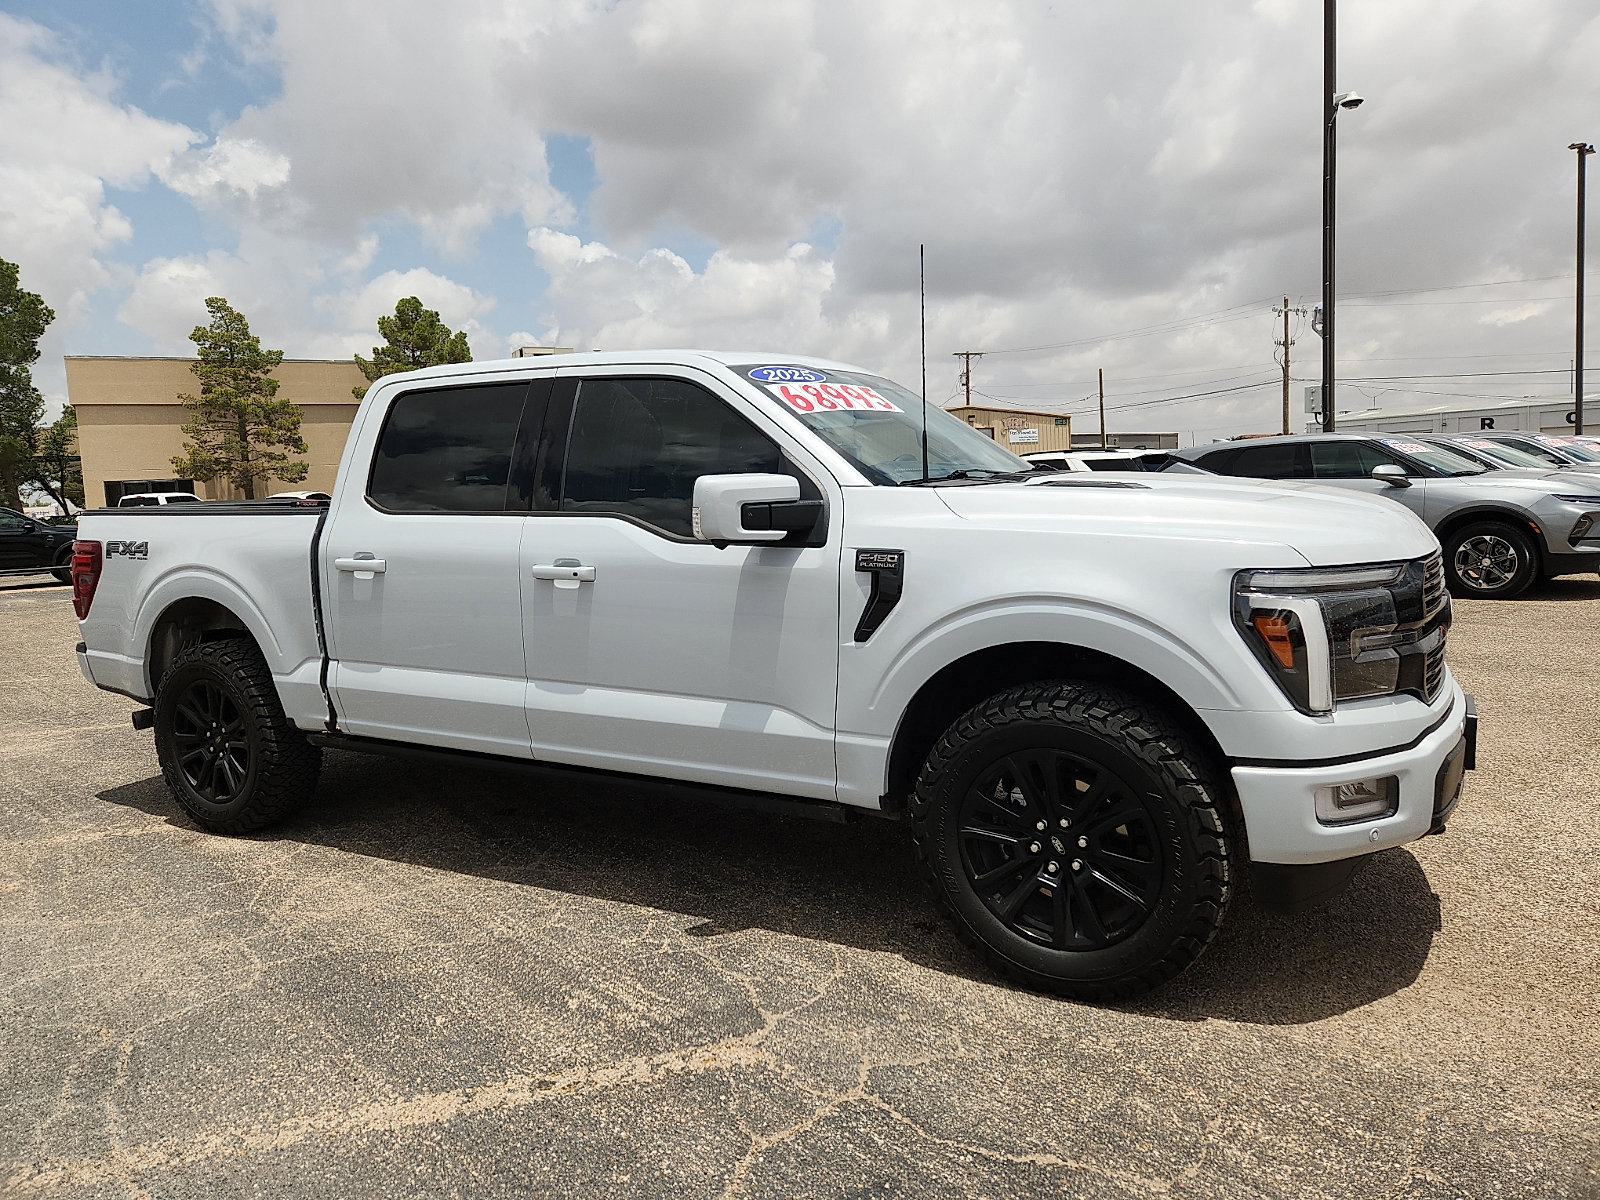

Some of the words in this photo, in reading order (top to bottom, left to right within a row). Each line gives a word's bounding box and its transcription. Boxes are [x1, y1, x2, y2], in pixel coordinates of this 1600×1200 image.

[763, 367, 816, 382] 2025
[780, 383, 895, 412] 68995
[1480, 417, 1495, 430] R
[105, 540, 149, 559] FX4
[859, 553, 899, 563] F-150
